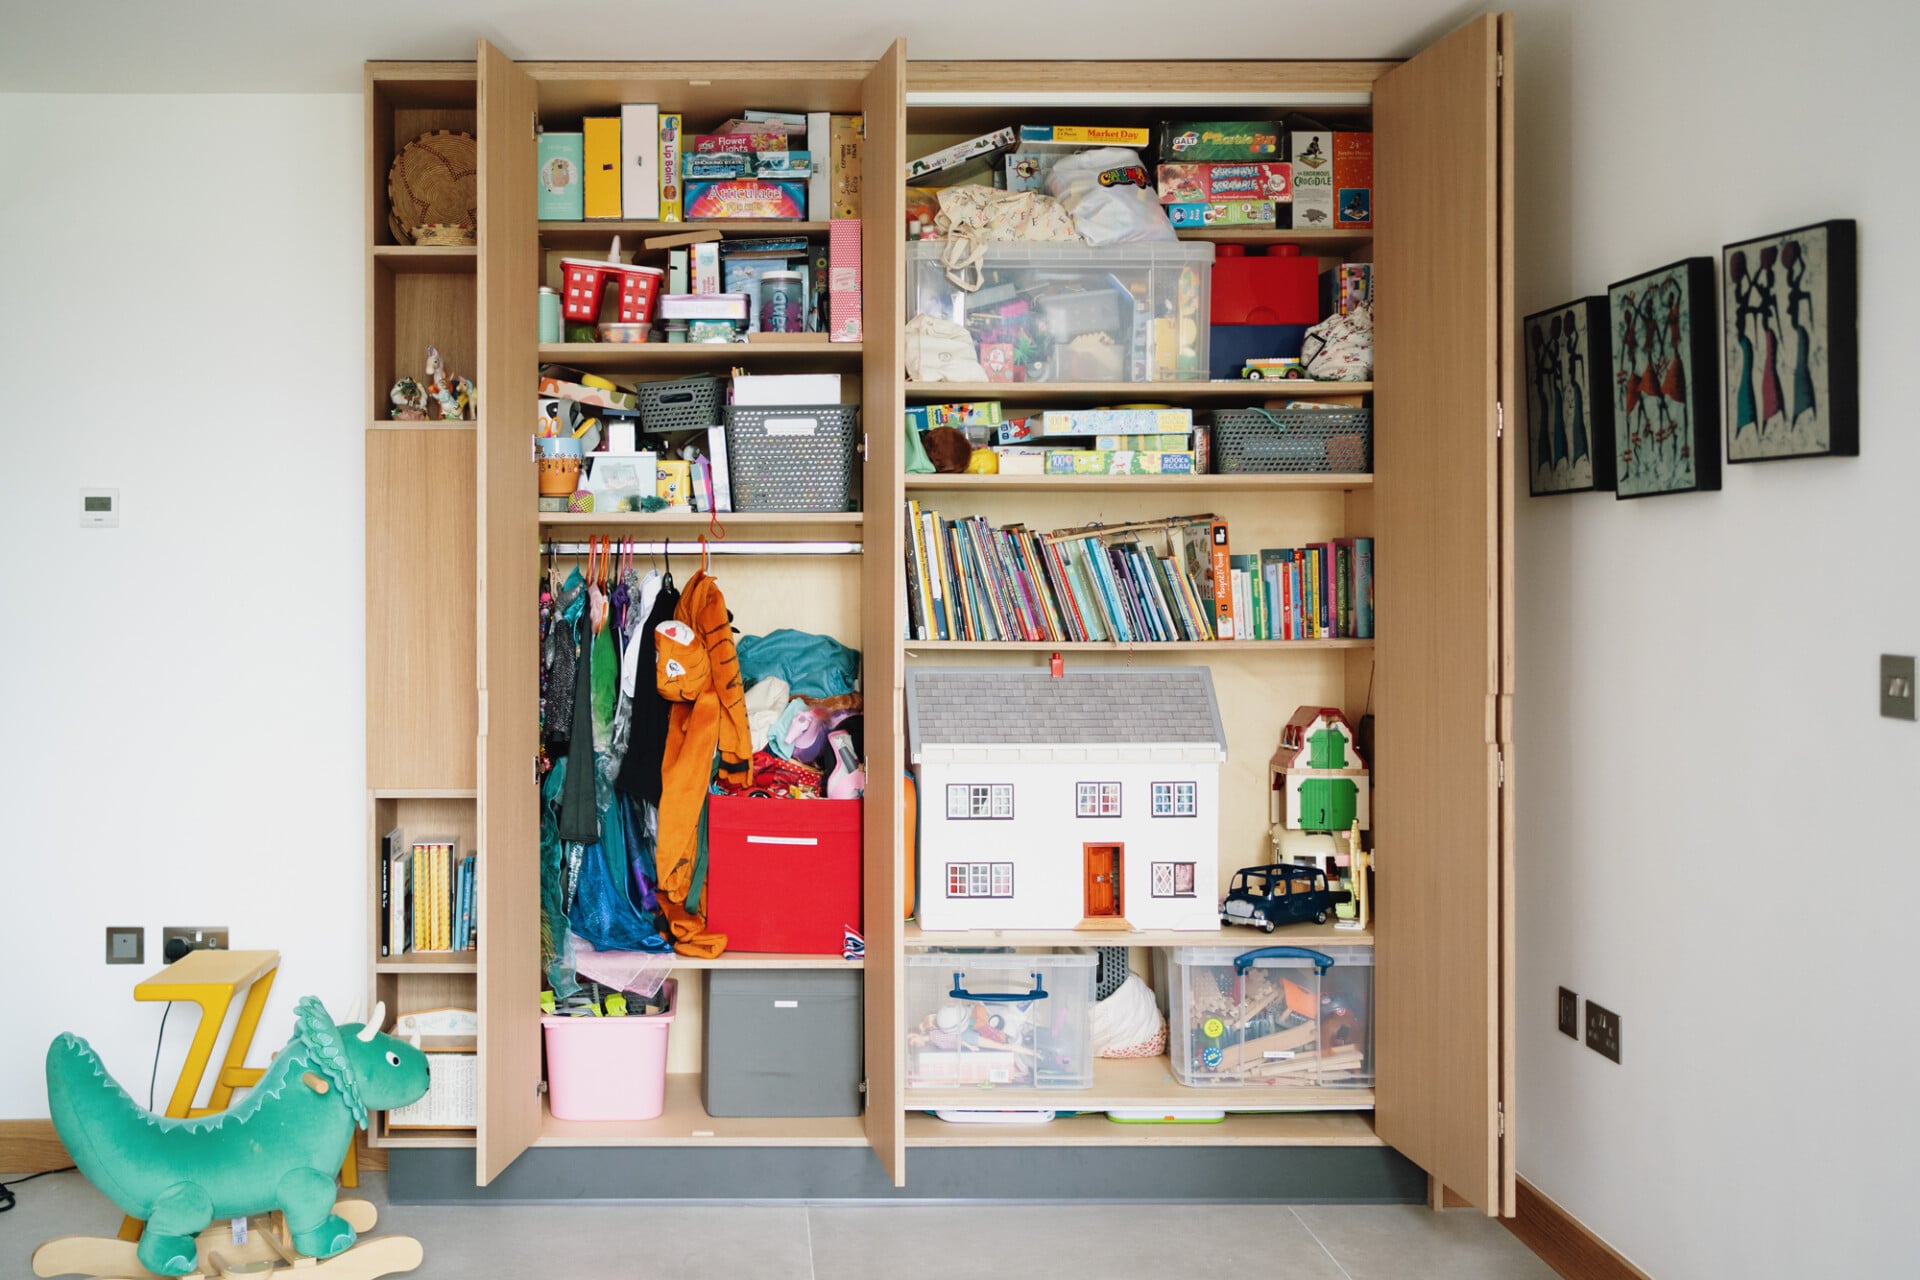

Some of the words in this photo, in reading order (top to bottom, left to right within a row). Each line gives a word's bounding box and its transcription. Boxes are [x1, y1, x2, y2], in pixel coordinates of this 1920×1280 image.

[1087, 129, 1118, 138] Market
[1120, 130, 1138, 140] Day
[718, 136, 747, 146] Flower
[1173, 137, 1198, 145] GALT
[664, 145, 673, 159] Lip
[664, 160, 673, 185] Balm
[1211, 180, 1259, 194] SCRAMBLE
[1294, 176, 1332, 187] CROCODILE
